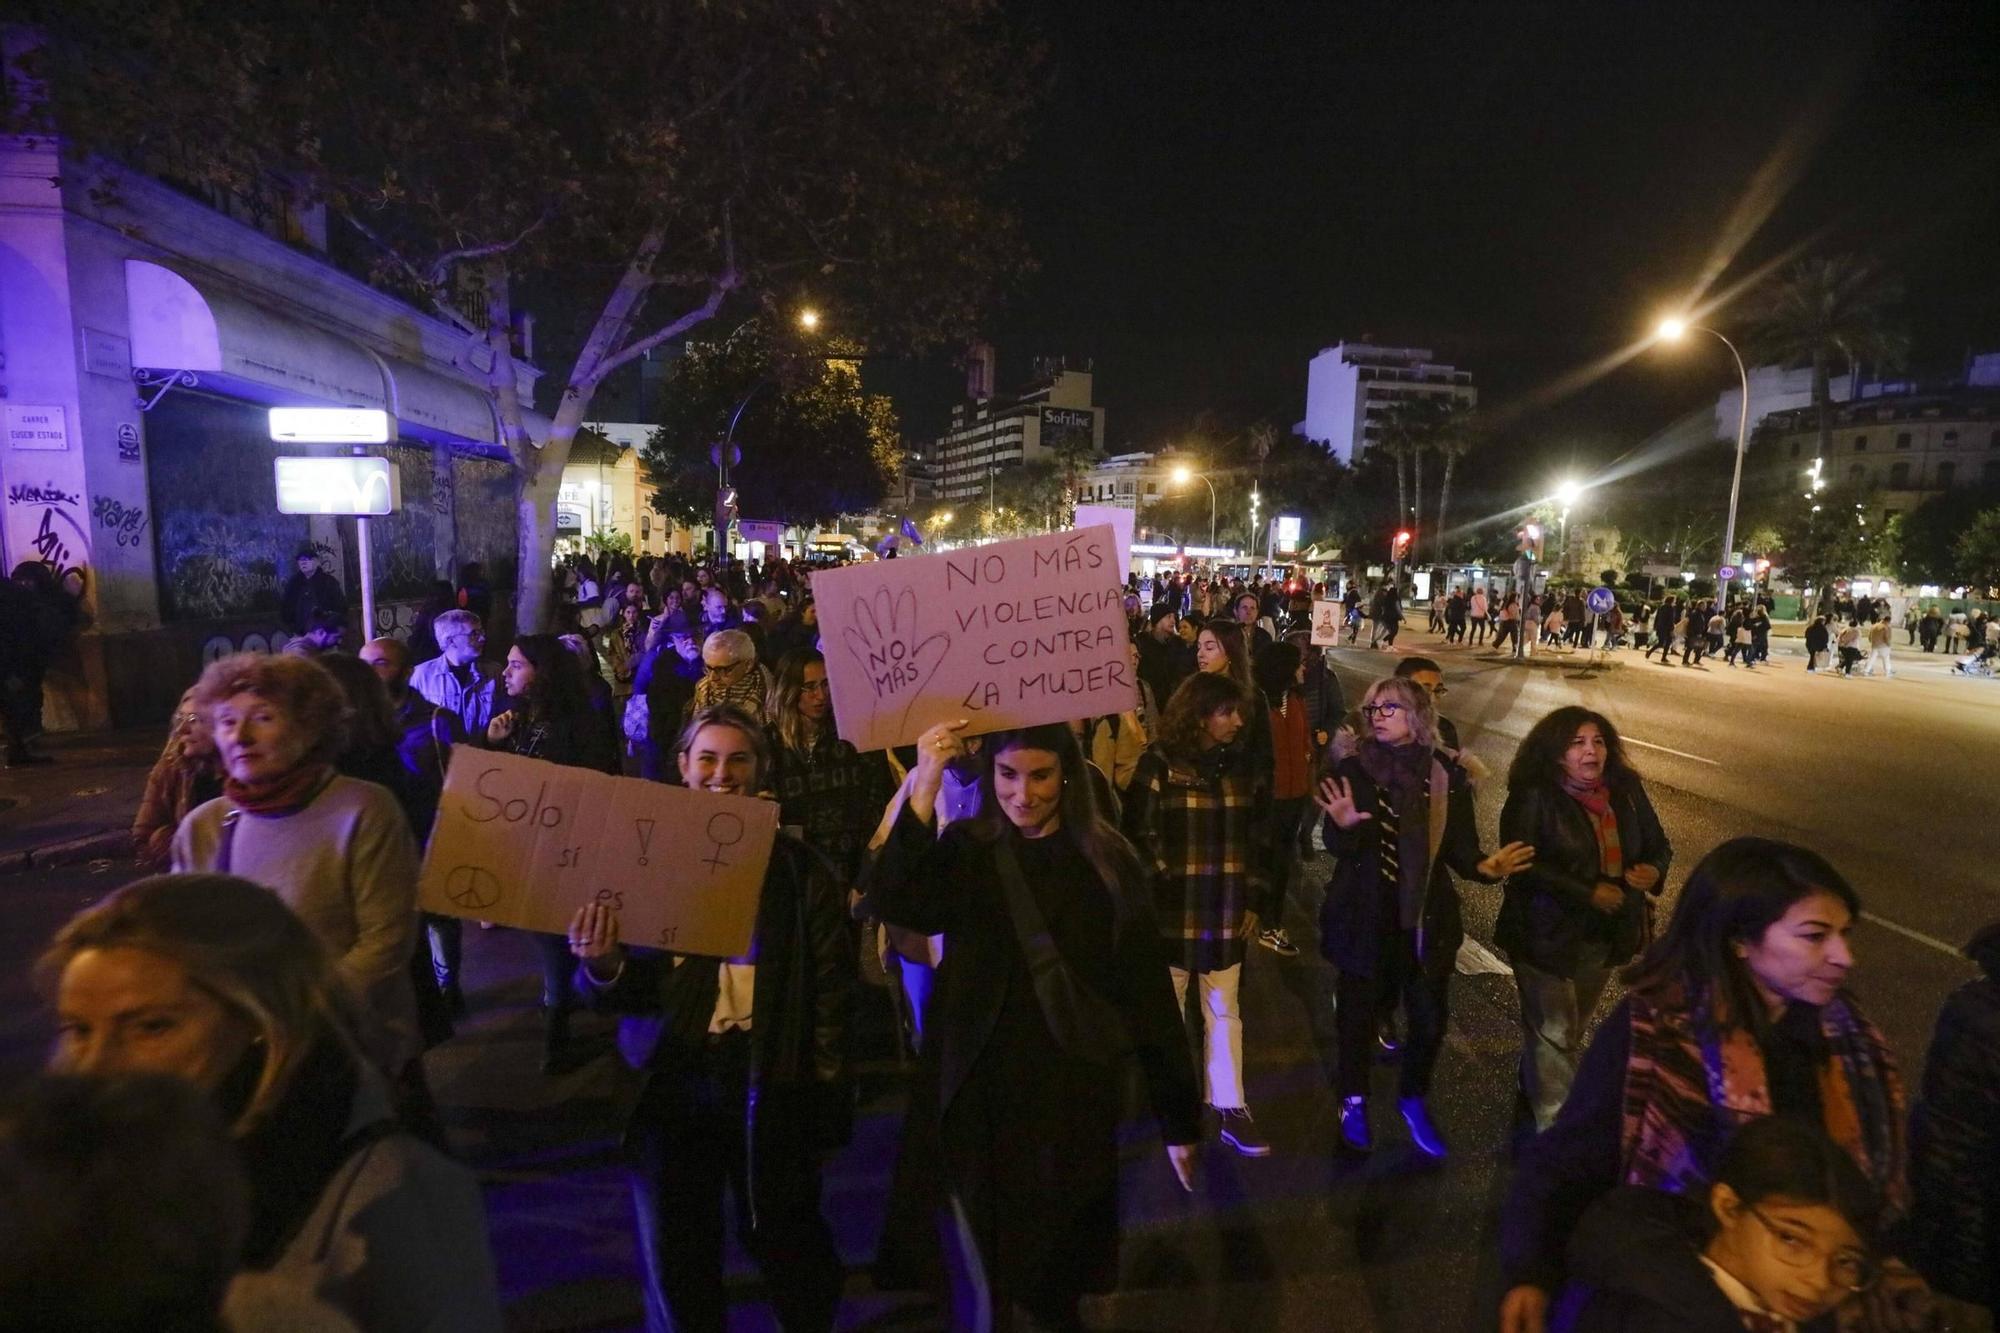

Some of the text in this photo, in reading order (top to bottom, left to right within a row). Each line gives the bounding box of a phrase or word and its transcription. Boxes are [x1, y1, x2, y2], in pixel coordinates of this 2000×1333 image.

[946, 534, 1103, 591] NO MÁS
[955, 587, 1122, 633] VIOLENCIA
[869, 639, 906, 671] NO
[983, 624, 1114, 666] CONTRA
[873, 661, 919, 698] MÁS
[962, 660, 1134, 711] LA MUJER
[460, 767, 563, 829] Solo
[595, 888, 624, 911] es
